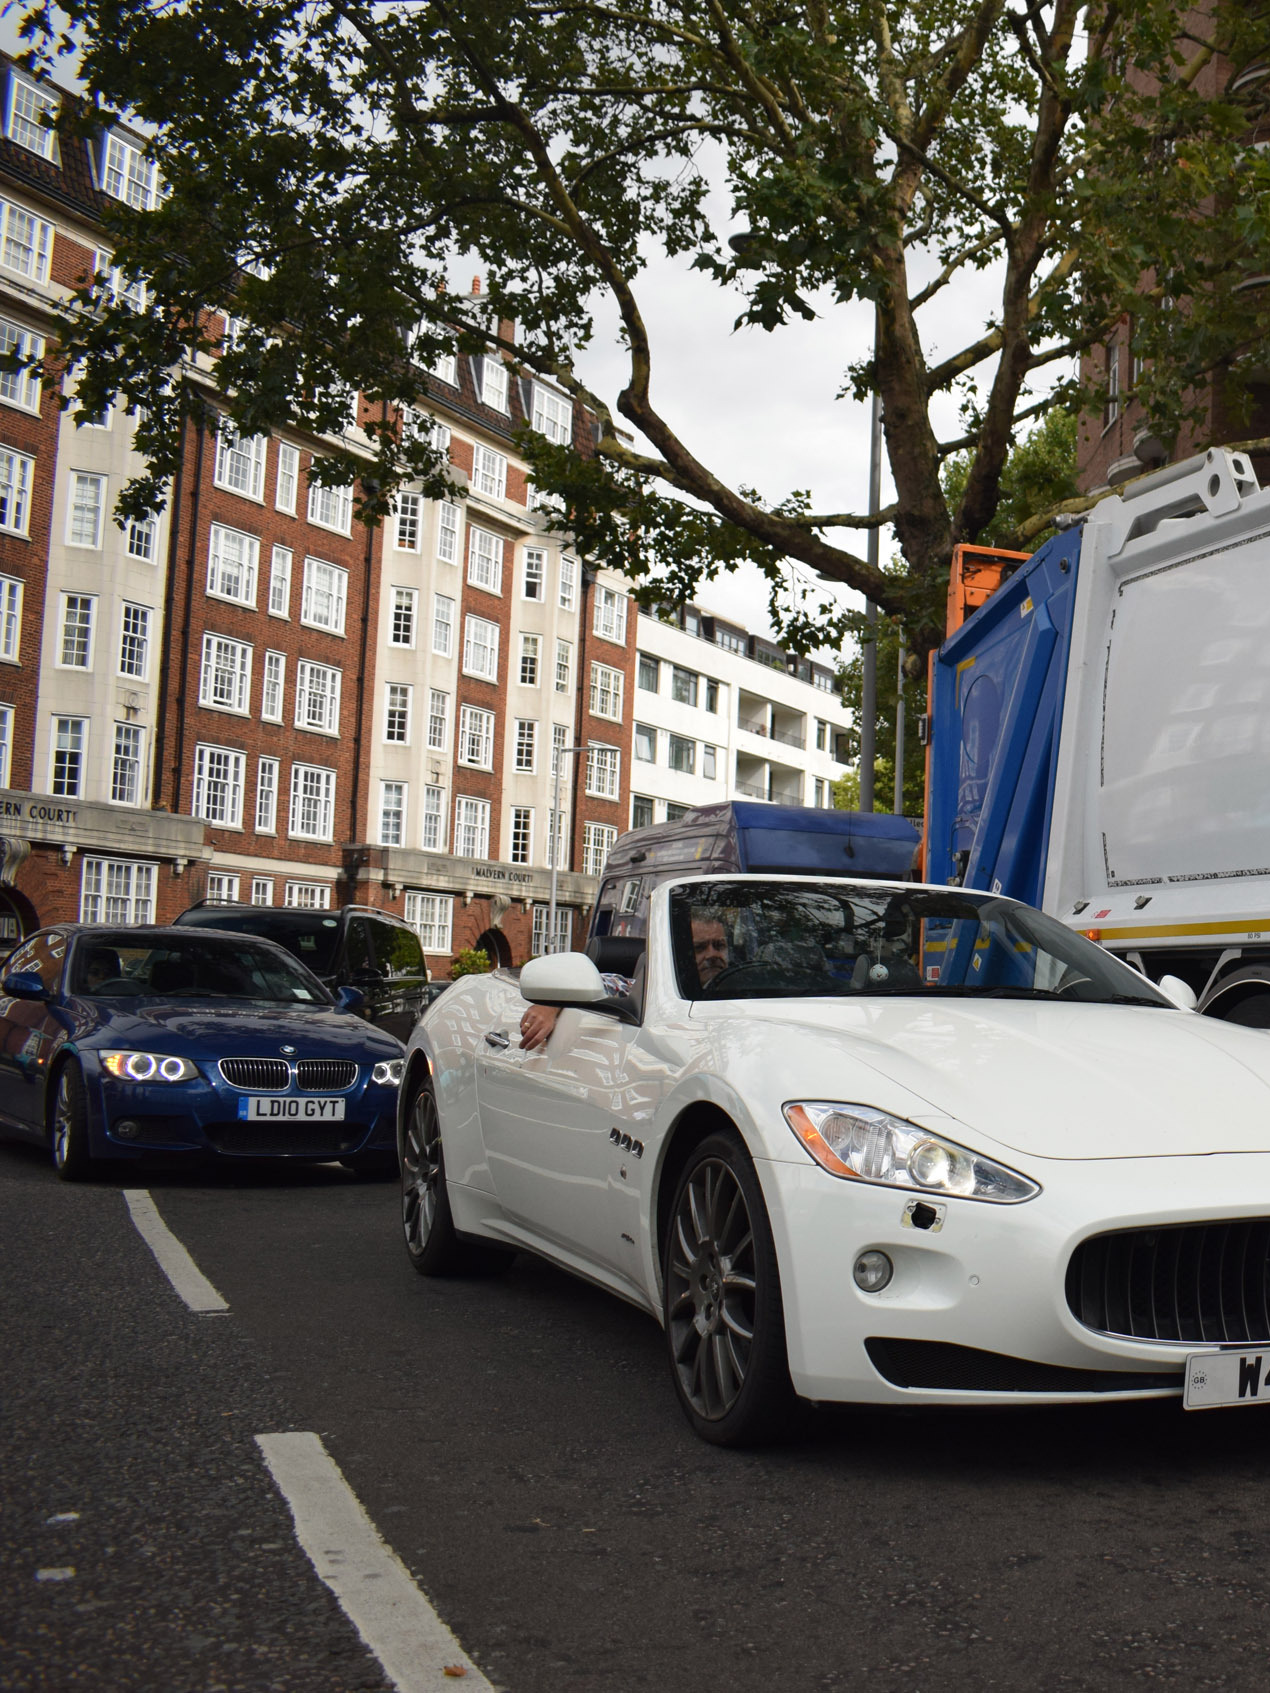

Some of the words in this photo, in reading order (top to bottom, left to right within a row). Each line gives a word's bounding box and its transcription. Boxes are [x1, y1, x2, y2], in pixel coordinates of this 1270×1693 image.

[30, 806, 72, 822] COURT
[475, 867, 505, 880] MALVERN
[508, 871, 530, 883] COURT
[256, 1100, 299, 1117] LD10
[305, 1100, 339, 1117] GYT
